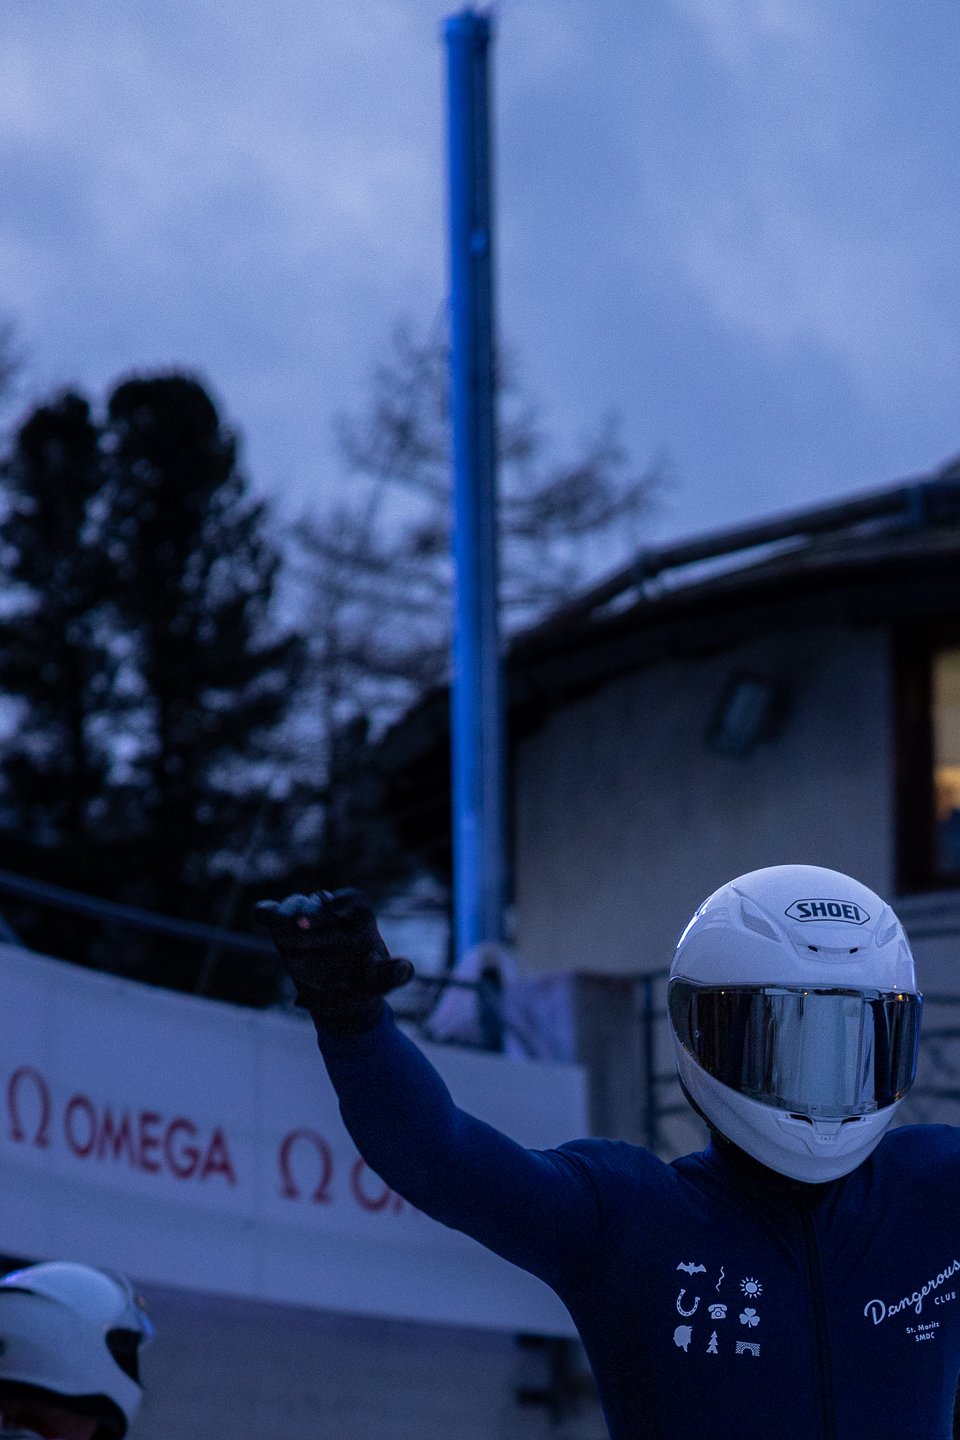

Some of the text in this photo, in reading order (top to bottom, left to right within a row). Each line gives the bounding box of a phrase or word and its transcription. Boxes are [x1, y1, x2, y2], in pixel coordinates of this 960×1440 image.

[797, 902, 860, 921] SHOEI
[64, 1094, 238, 1188] OMEGA
[934, 1291, 956, 1305] CLUB
[918, 1321, 940, 1331] Moritz
[915, 1332, 935, 1342] SMDC
